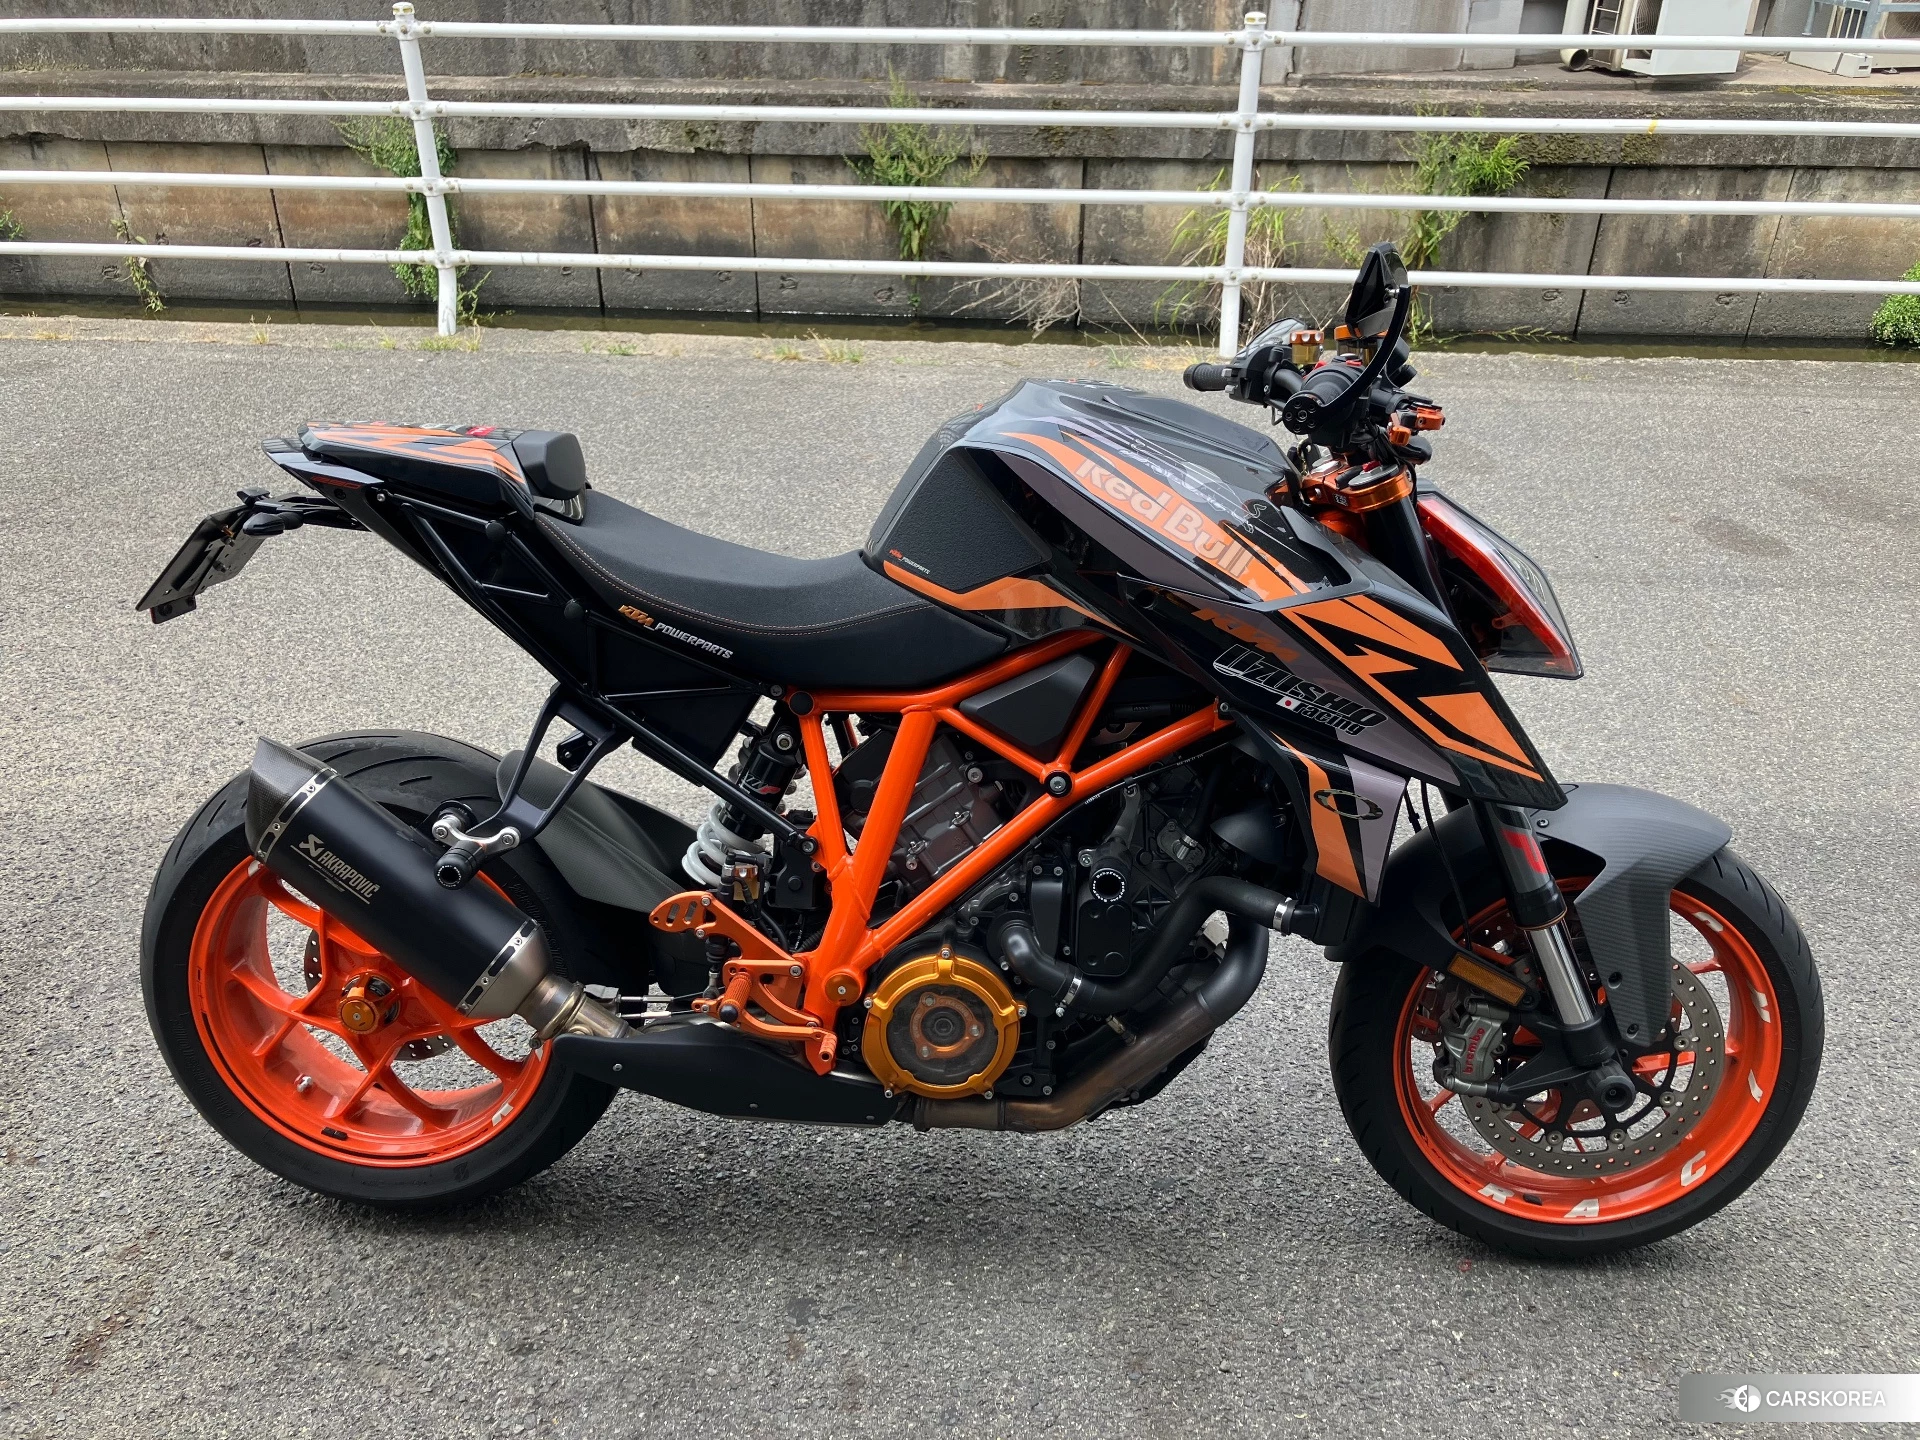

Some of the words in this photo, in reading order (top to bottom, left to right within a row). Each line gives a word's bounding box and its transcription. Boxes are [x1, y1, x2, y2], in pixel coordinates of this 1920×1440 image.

[1074, 458, 1173, 522] Red
[1163, 503, 1254, 578] Bull
[1295, 701, 1367, 736] racing
[1463, 1027, 1486, 1075] brembo
